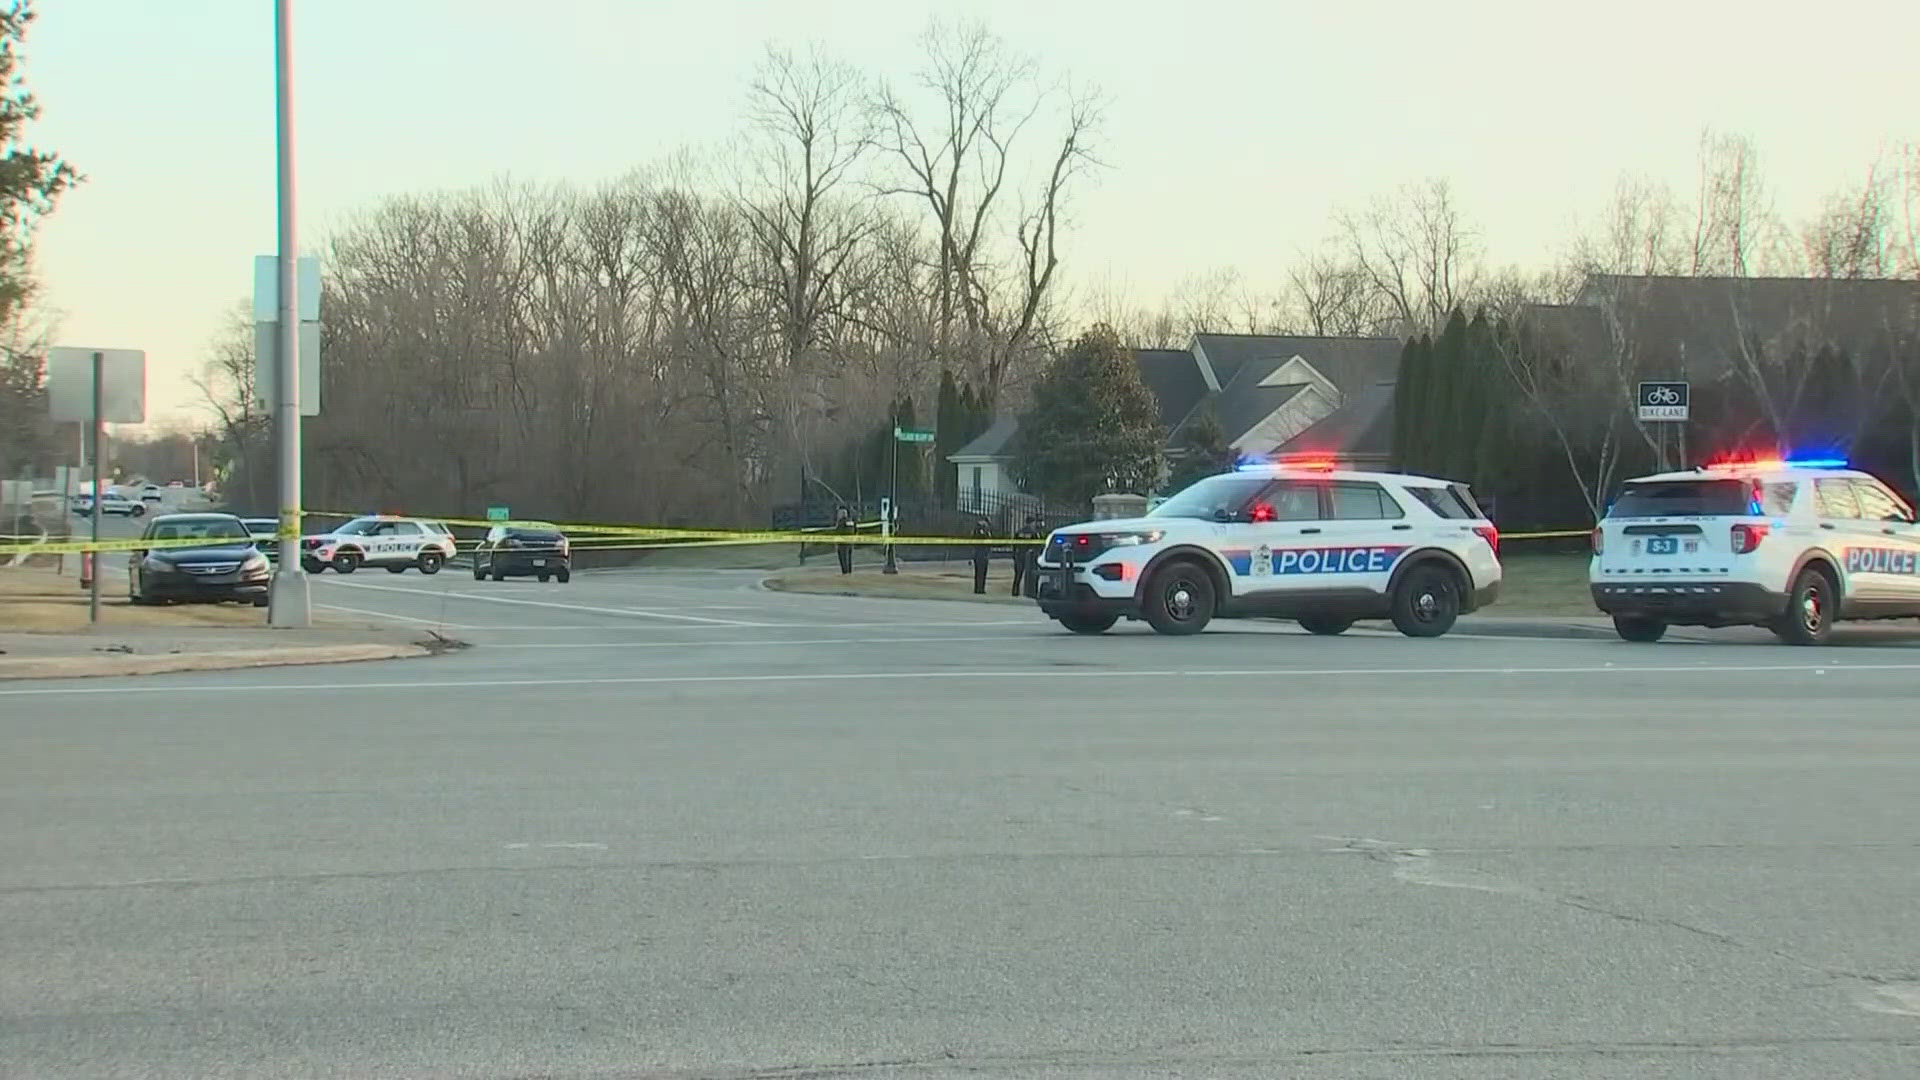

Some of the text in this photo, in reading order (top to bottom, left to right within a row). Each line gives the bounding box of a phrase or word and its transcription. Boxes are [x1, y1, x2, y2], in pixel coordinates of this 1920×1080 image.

[1642, 408, 1685, 417] BIKE LANE
[1652, 540, 1671, 552] S-3
[1279, 548, 1385, 574] POLICE
[1849, 549, 1915, 573] POLICE
